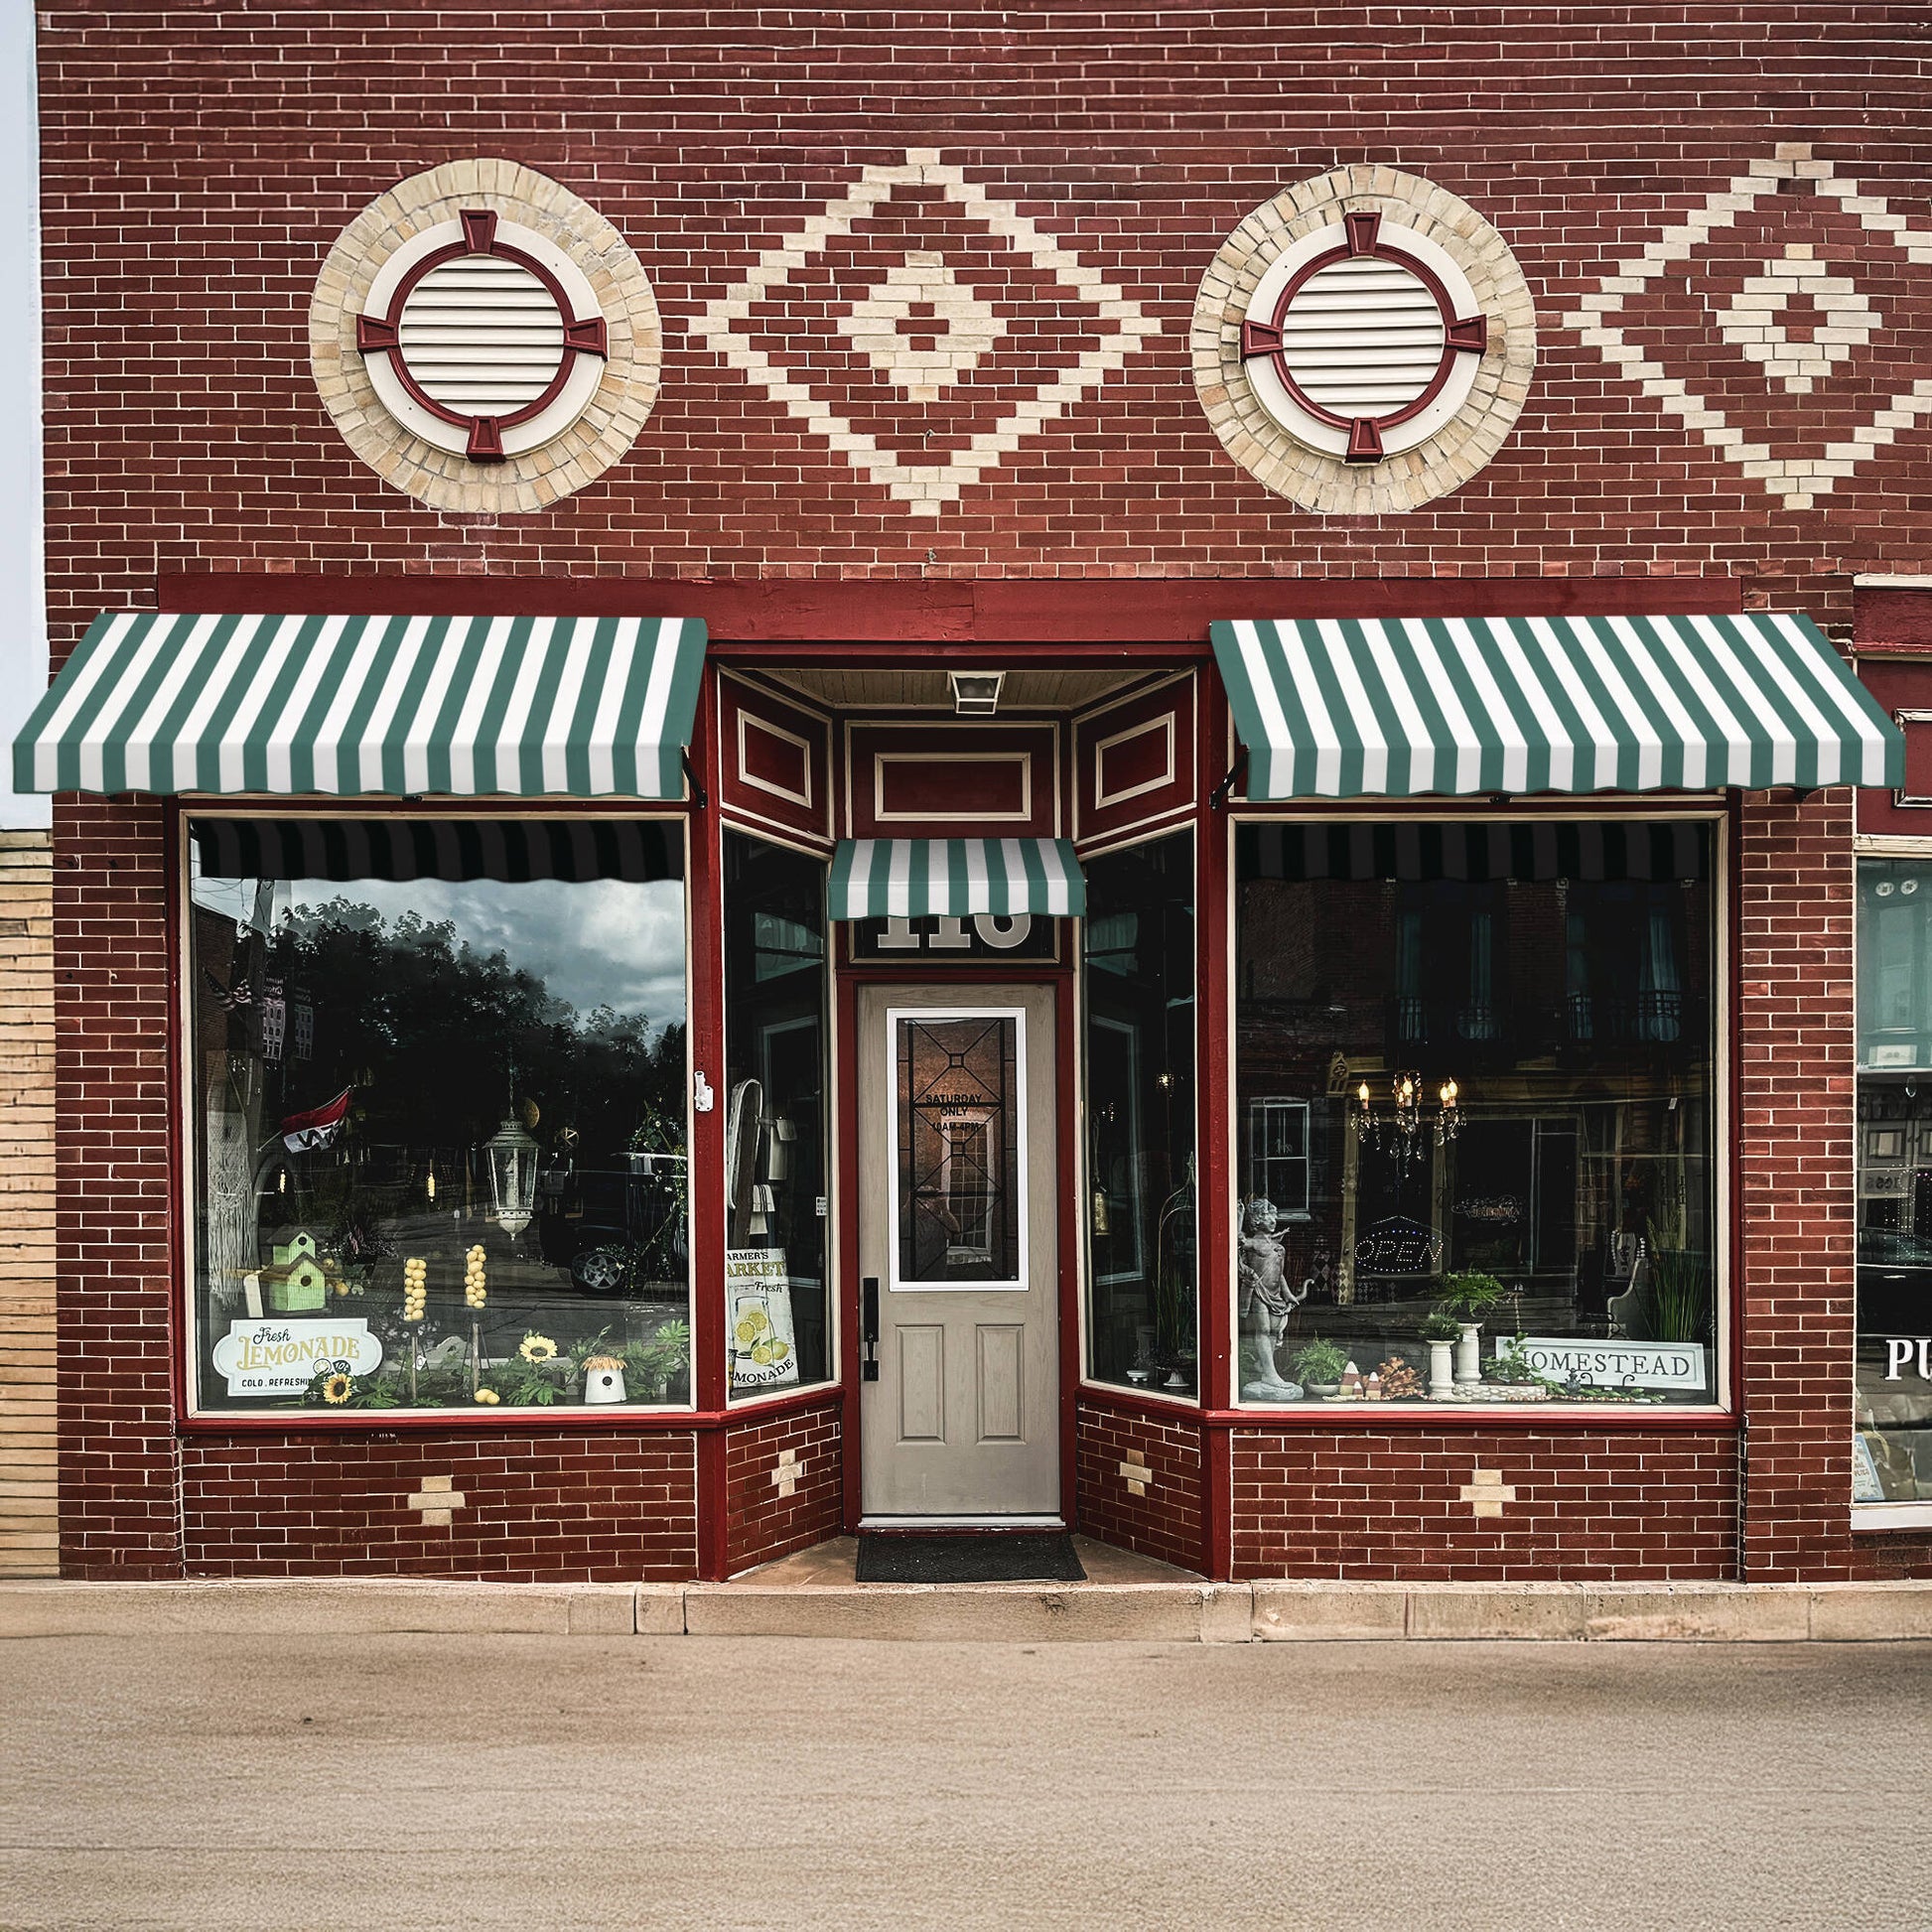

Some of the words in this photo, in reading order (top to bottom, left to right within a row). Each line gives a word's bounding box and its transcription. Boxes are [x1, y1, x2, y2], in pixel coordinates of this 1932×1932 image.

[926, 1094, 982, 1103] SATURDAY
[940, 1106, 968, 1116] ONLY
[1354, 1240, 1444, 1263] OPEN
[755, 1281, 782, 1293] Fresh
[253, 1326, 291, 1344] Fresh
[236, 1335, 359, 1370] LEMONADE
[731, 1358, 794, 1383] MONADE
